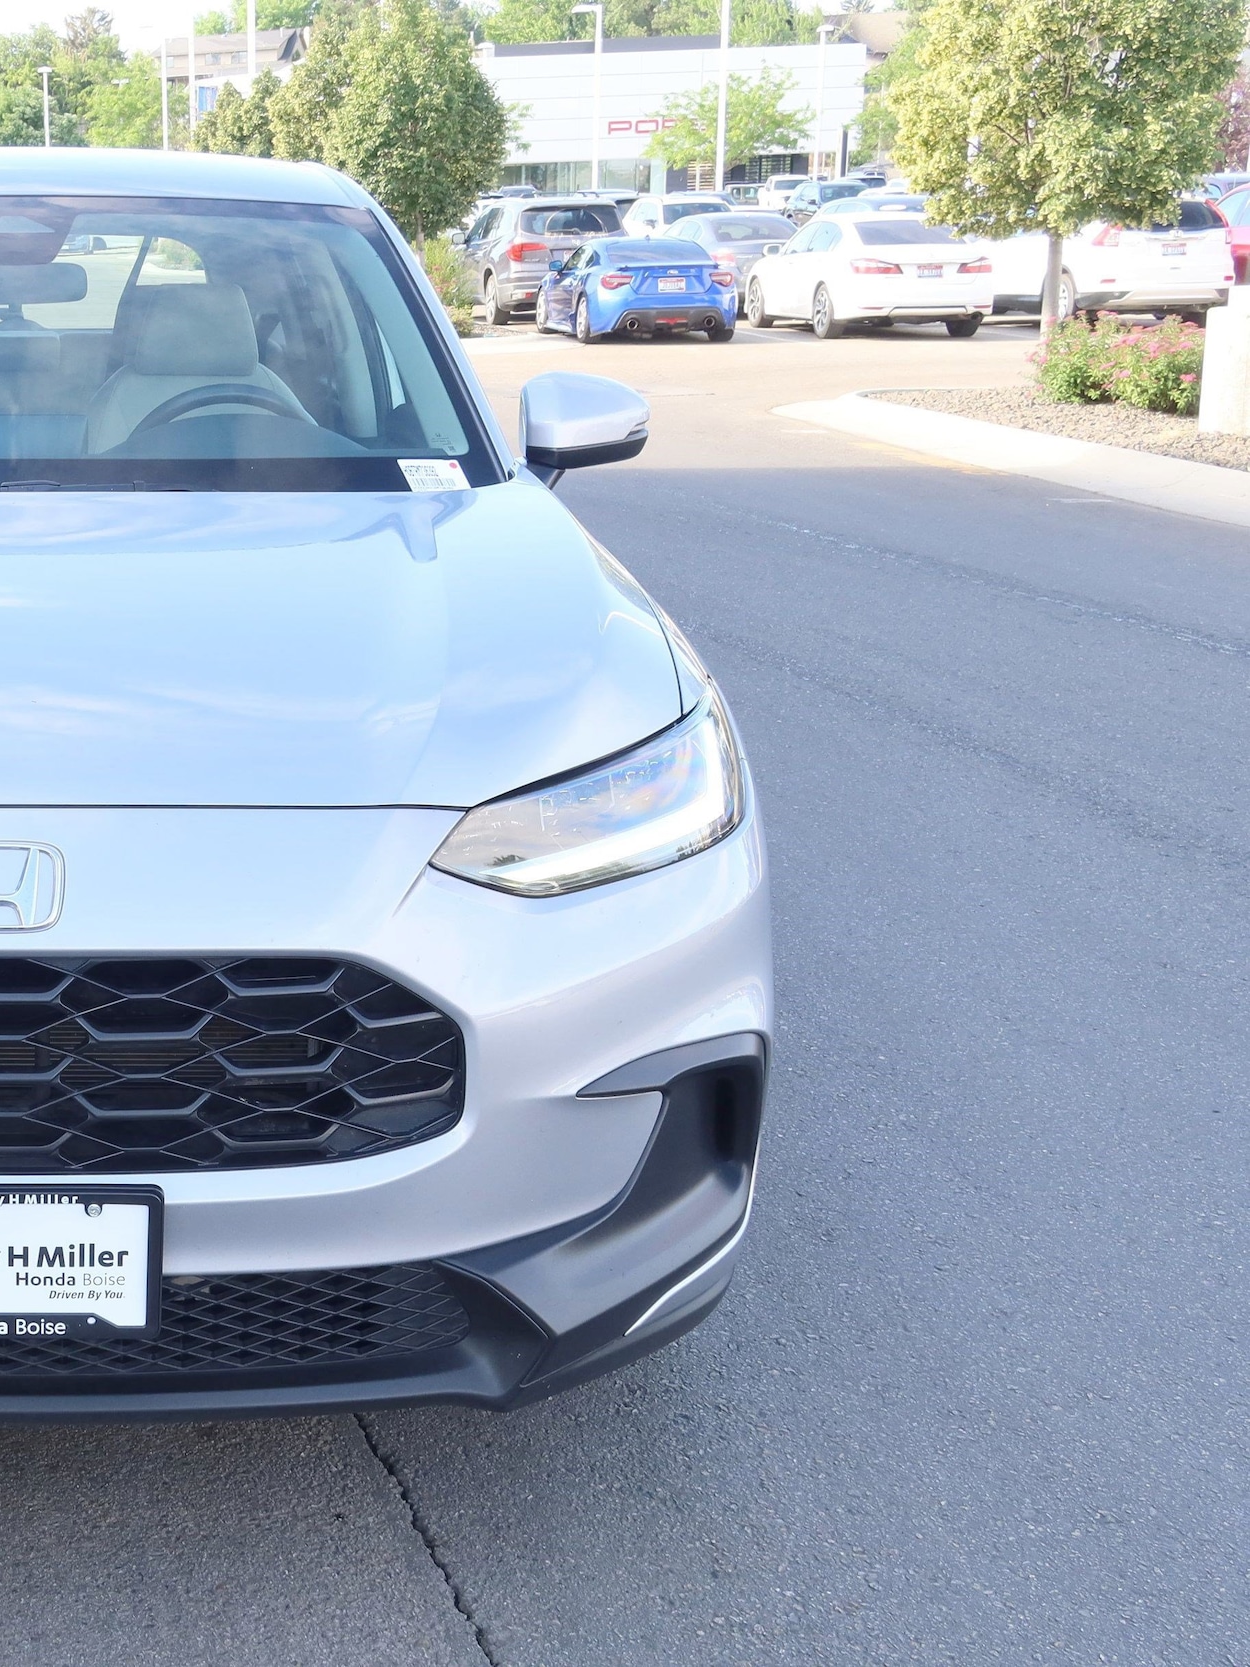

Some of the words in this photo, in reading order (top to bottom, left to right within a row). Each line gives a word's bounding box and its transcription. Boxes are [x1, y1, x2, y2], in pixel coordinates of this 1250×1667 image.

[8, 1193, 21, 1205] H
[23, 1193, 80, 1205] Miller
[7, 1246, 30, 1268] H
[36, 1243, 130, 1268] Miller
[15, 1272, 76, 1287] Honda
[82, 1273, 127, 1287] Boise
[48, 1289, 85, 1300] Driven
[87, 1289, 102, 1302] By
[15, 1317, 67, 1336] Boise
